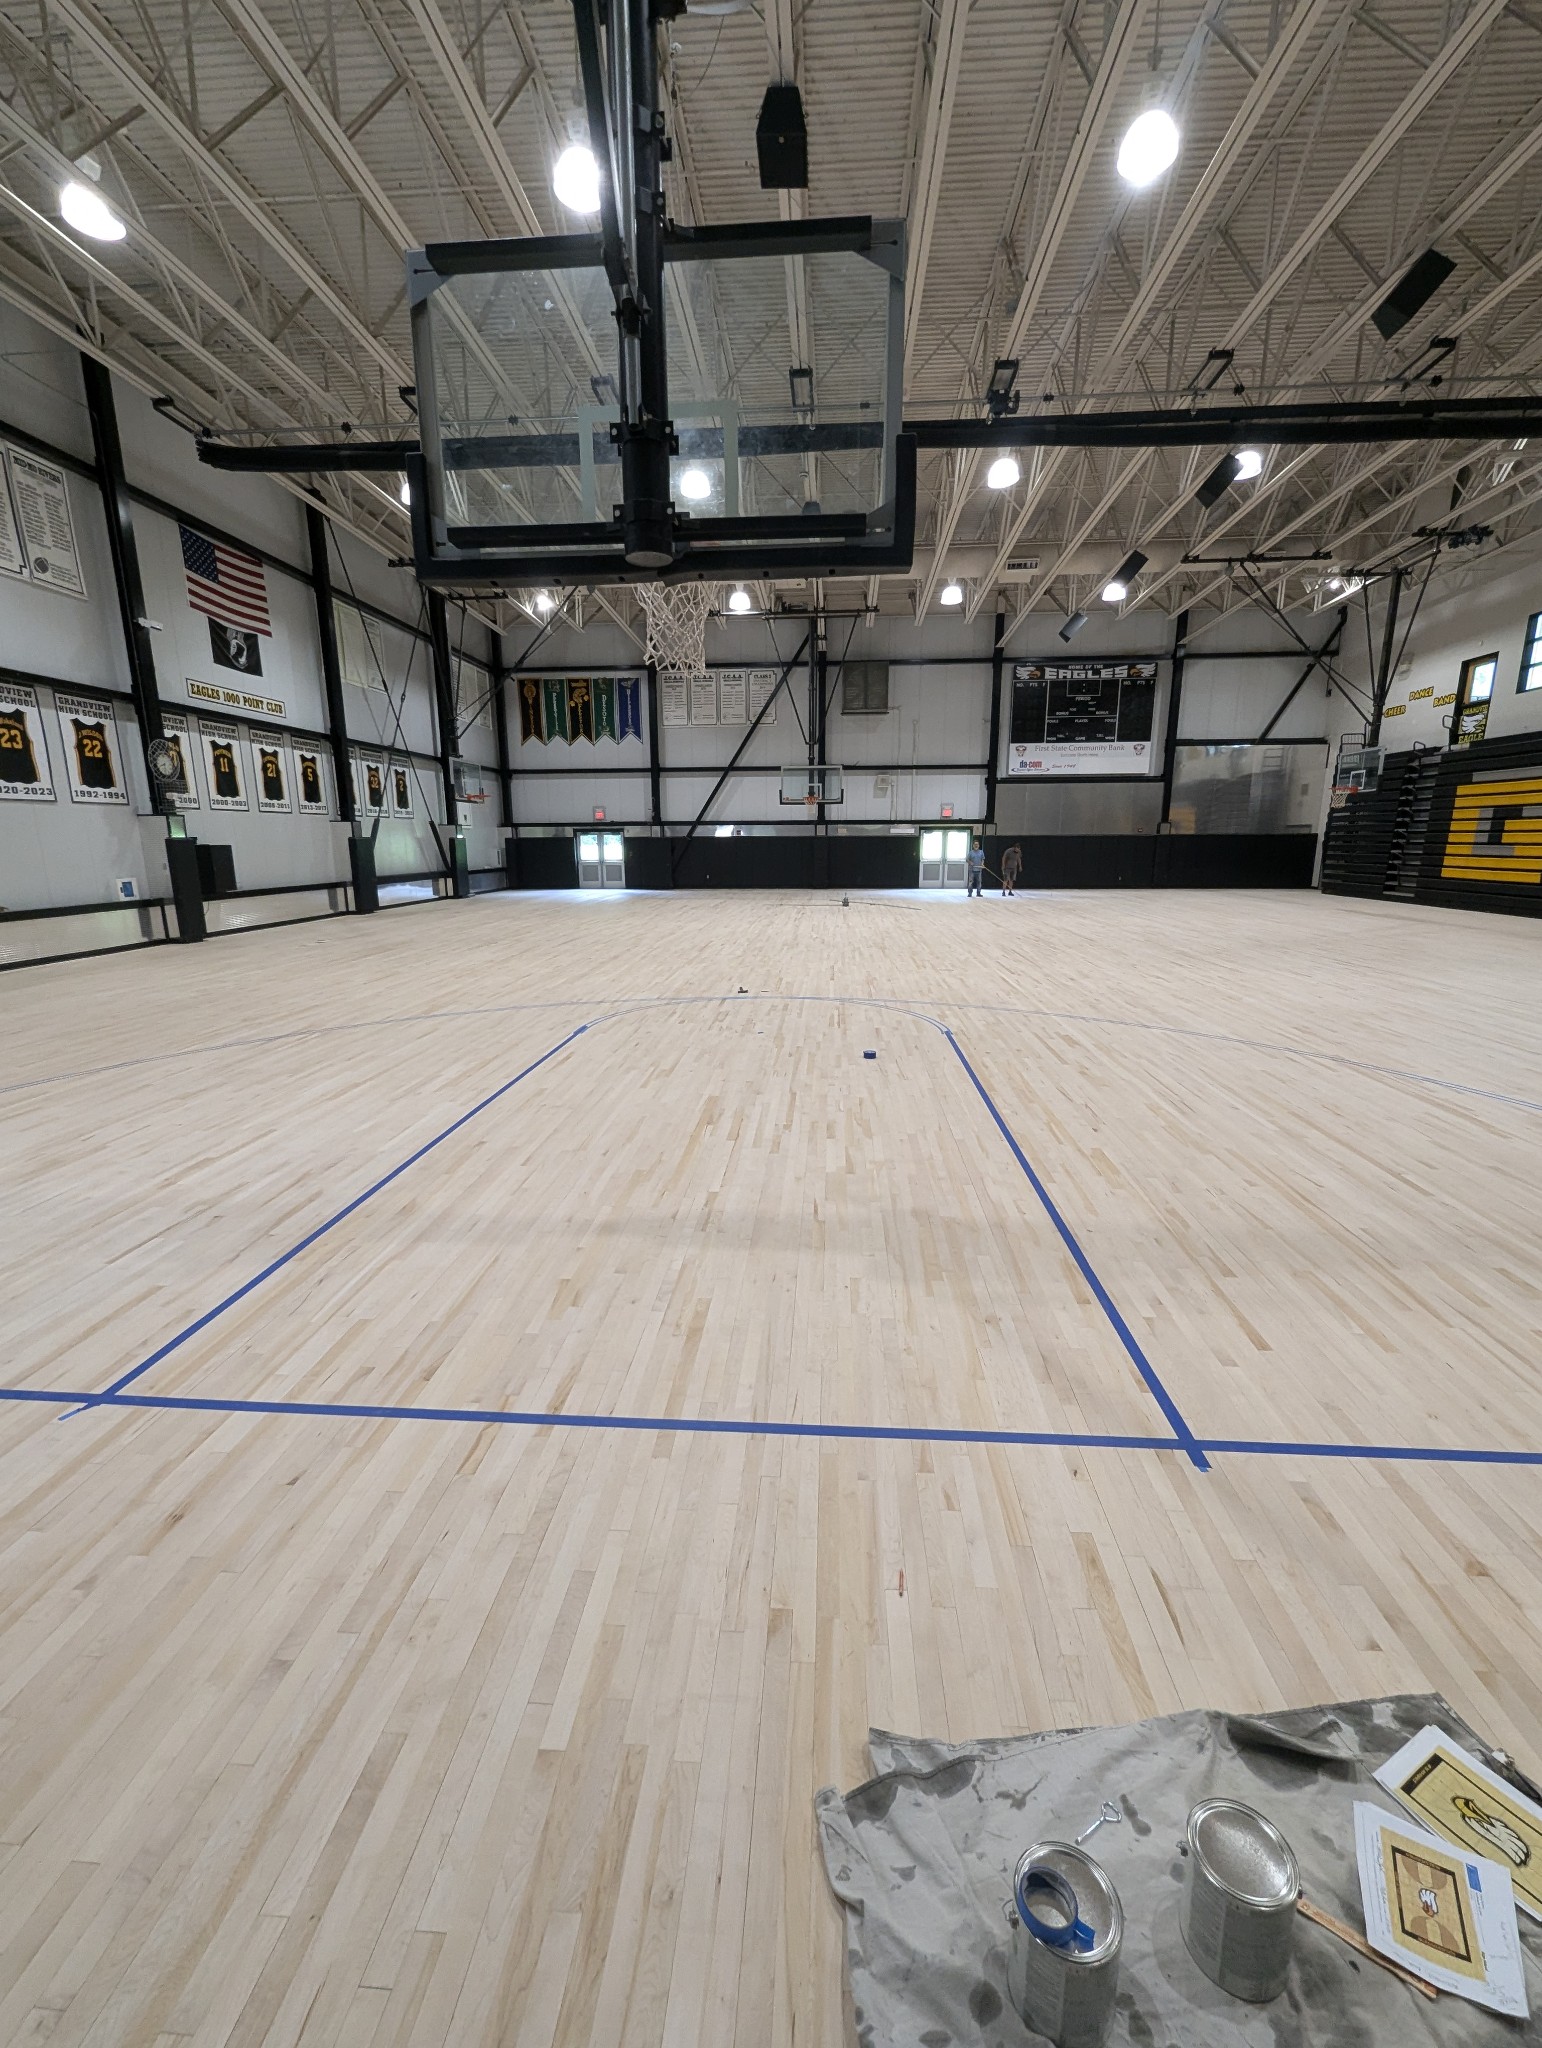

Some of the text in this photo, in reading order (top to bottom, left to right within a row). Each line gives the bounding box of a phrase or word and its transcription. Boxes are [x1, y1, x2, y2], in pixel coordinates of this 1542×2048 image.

[1044, 665, 1129, 679] EAGLES
[190, 683, 283, 714] EAGLES 1000 POINT CLUB
[1409, 686, 1434, 701] DANCE
[1433, 693, 1457, 708] BAND
[58, 697, 111, 712] GRANDVIEW
[1383, 705, 1406, 718] CHEER
[58, 705, 113, 720] HIGH SCHOOL
[202, 723, 236, 734] GRANDVIEW
[0, 728, 23, 749] 23
[217, 732, 239, 740] SCHOOL
[82, 739, 103, 758] 22
[1068, 744, 1107, 753] Community
[220, 757, 229, 772] 11
[266, 763, 276, 777] 21
[307, 768, 313, 782] 5
[74, 790, 126, 800] 1992-1994
